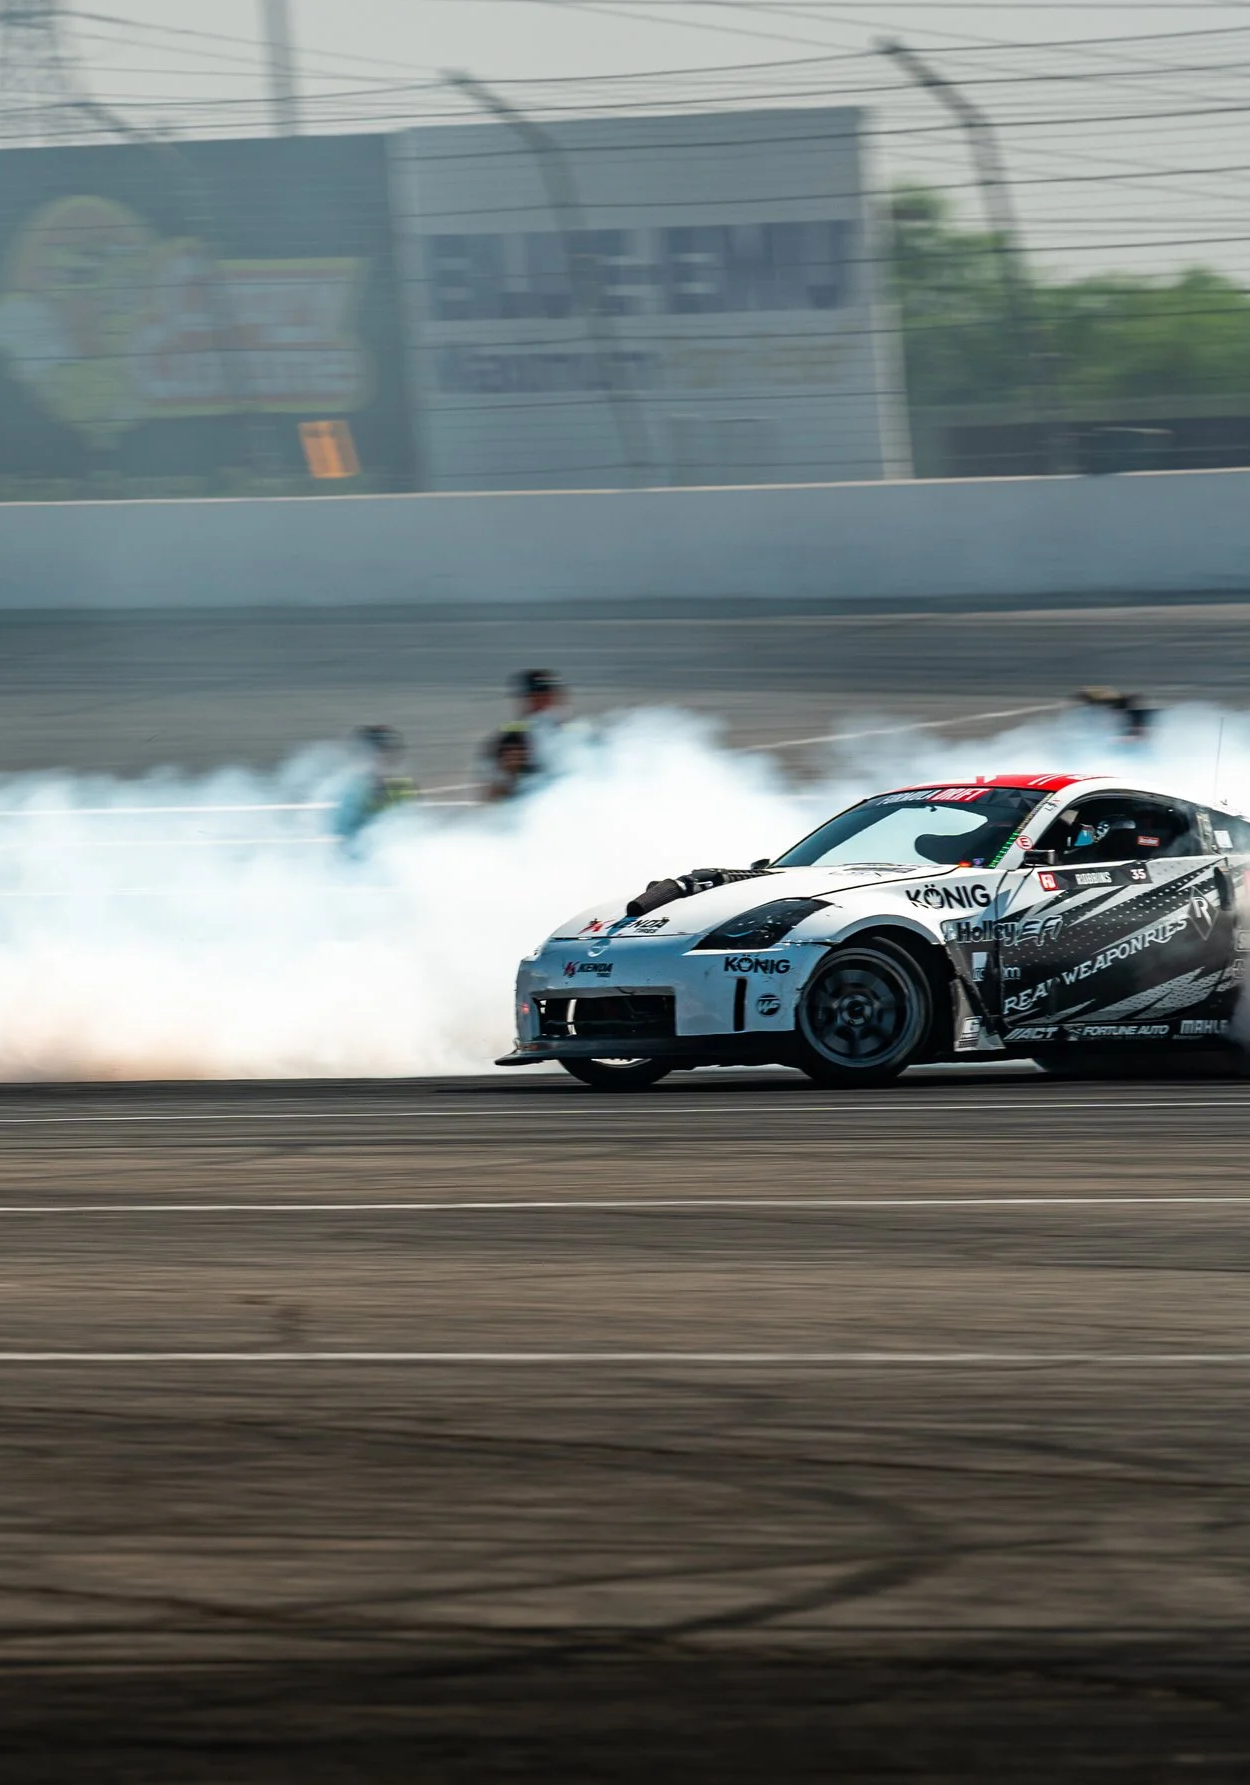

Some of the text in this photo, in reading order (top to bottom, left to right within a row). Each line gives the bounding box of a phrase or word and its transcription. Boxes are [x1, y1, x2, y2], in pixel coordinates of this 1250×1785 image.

[932, 788, 991, 802] DRIFT
[1130, 868, 1147, 881] 35
[905, 884, 991, 909] KÖNIG
[1061, 915, 1188, 986] WEAPONRIES
[723, 953, 792, 975] KÖNIG
[1082, 1025, 1170, 1036] FORTUNE AUTO
